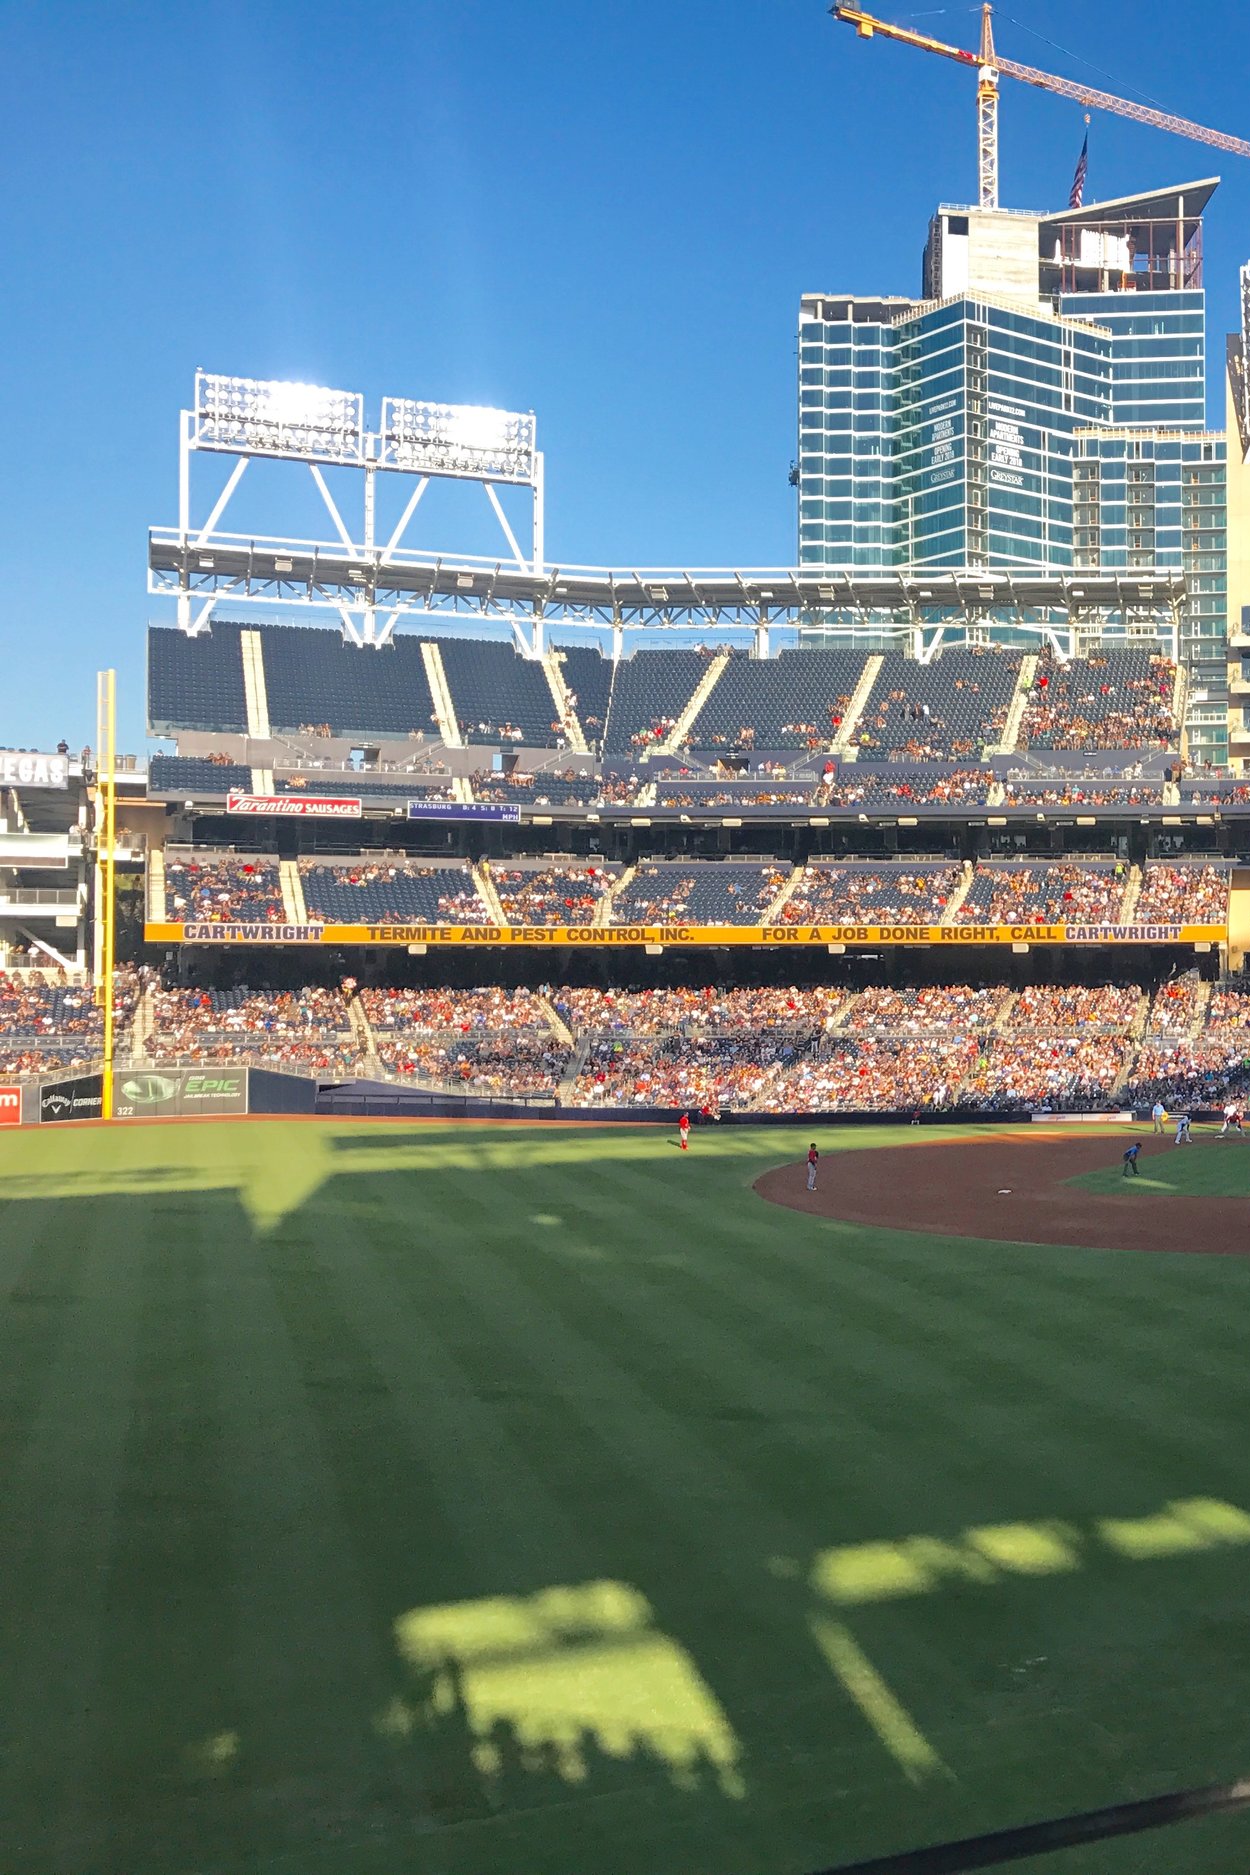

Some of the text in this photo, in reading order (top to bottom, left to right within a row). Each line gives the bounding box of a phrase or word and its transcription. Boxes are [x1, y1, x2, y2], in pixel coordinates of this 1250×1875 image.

[0, 757, 64, 784] EGAS
[231, 796, 360, 815] Tarantino SAUSAGES
[409, 803, 452, 811] STRASBURG
[502, 813, 519, 821] MPH
[184, 923, 324, 940] CARTWRIGHT
[367, 926, 695, 943] TERMITE AND PEST CONTROL, INC.
[762, 925, 1182, 942] FOR A JOB DONE RIGHT, CALL CARTWRIGHT
[185, 1080, 240, 1091] EPIC
[73, 1097, 102, 1107] CORNER
[117, 1106, 134, 1116] 322
